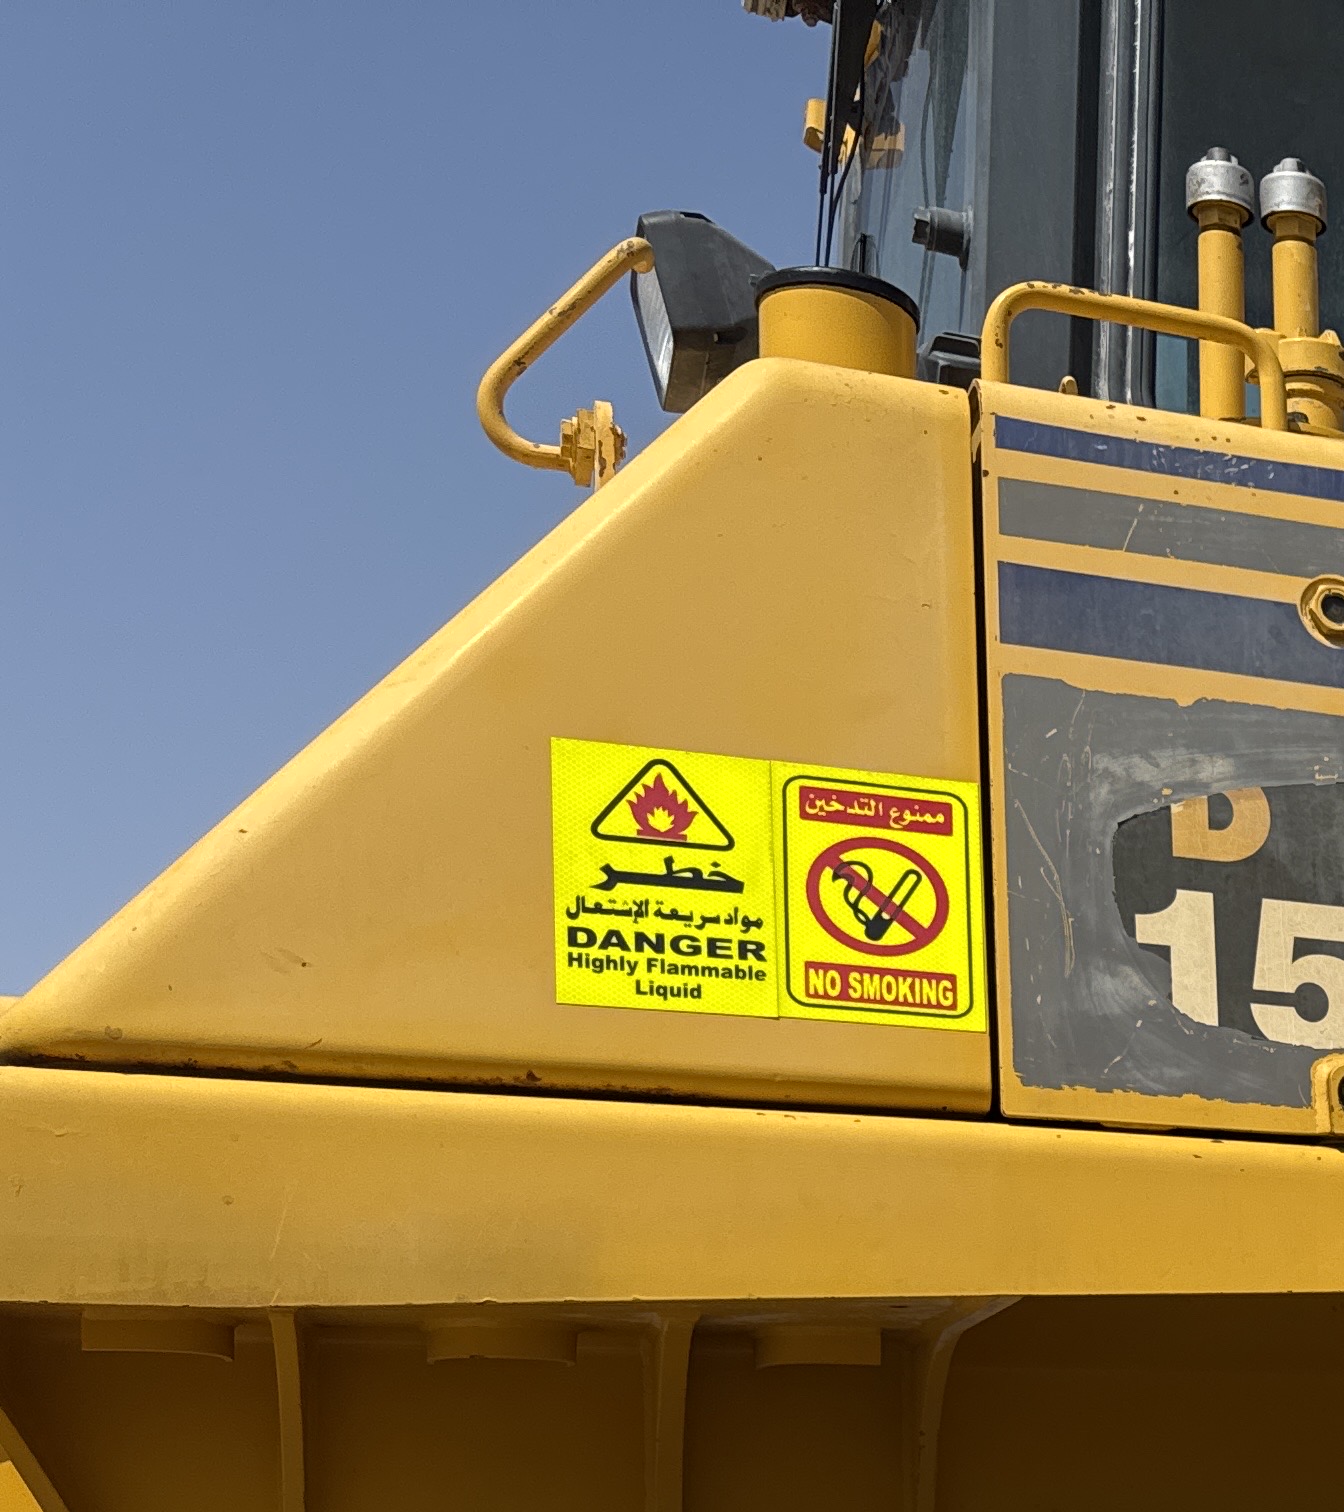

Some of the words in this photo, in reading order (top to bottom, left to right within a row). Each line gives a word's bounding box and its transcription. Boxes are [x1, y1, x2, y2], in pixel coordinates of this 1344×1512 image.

[805, 793, 883, 817] التدخين
[889, 804, 945, 829] ممنوع
[588, 855, 745, 894] خطر
[653, 900, 721, 931] سريعة
[723, 906, 764, 934] مواد
[567, 926, 768, 962] DANGER
[567, 952, 639, 976] Highly
[646, 957, 767, 981] Flammable
[635, 979, 702, 1001] Liquid
[808, 968, 842, 997] NO
[848, 972, 954, 1006] SMOKING
